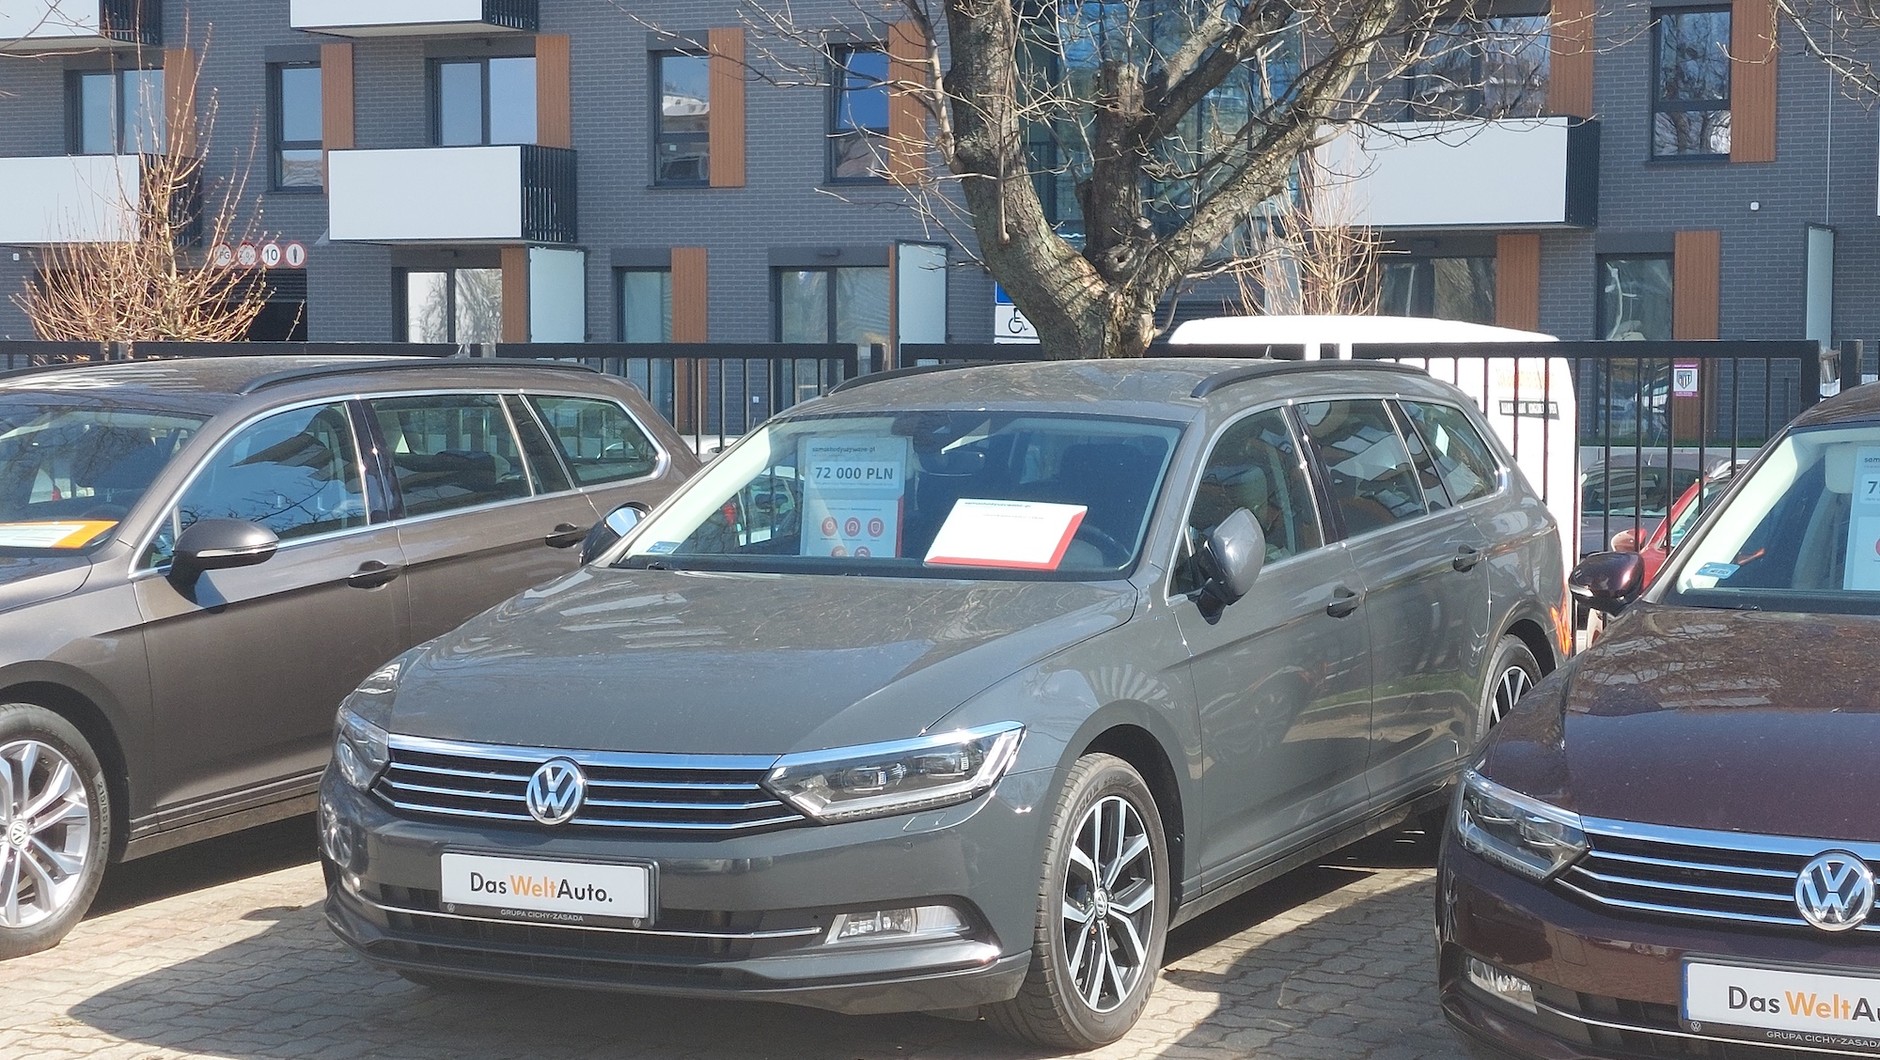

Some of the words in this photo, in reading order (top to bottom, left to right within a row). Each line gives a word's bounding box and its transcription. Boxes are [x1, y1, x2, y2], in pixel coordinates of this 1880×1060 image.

[266, 248, 278, 261] 10
[815, 467, 831, 479] 72
[836, 467, 862, 480] 000
[866, 467, 894, 480] PLN
[470, 871, 507, 894] Das
[510, 874, 613, 903] WeltAuto.
[501, 909, 527, 917] GRUPA
[528, 911, 584, 922] CICHY-ZASADA
[1728, 985, 1780, 1014] Das
[1785, 990, 1880, 1023] WeltA
[1766, 1031, 1803, 1041] GRUPA
